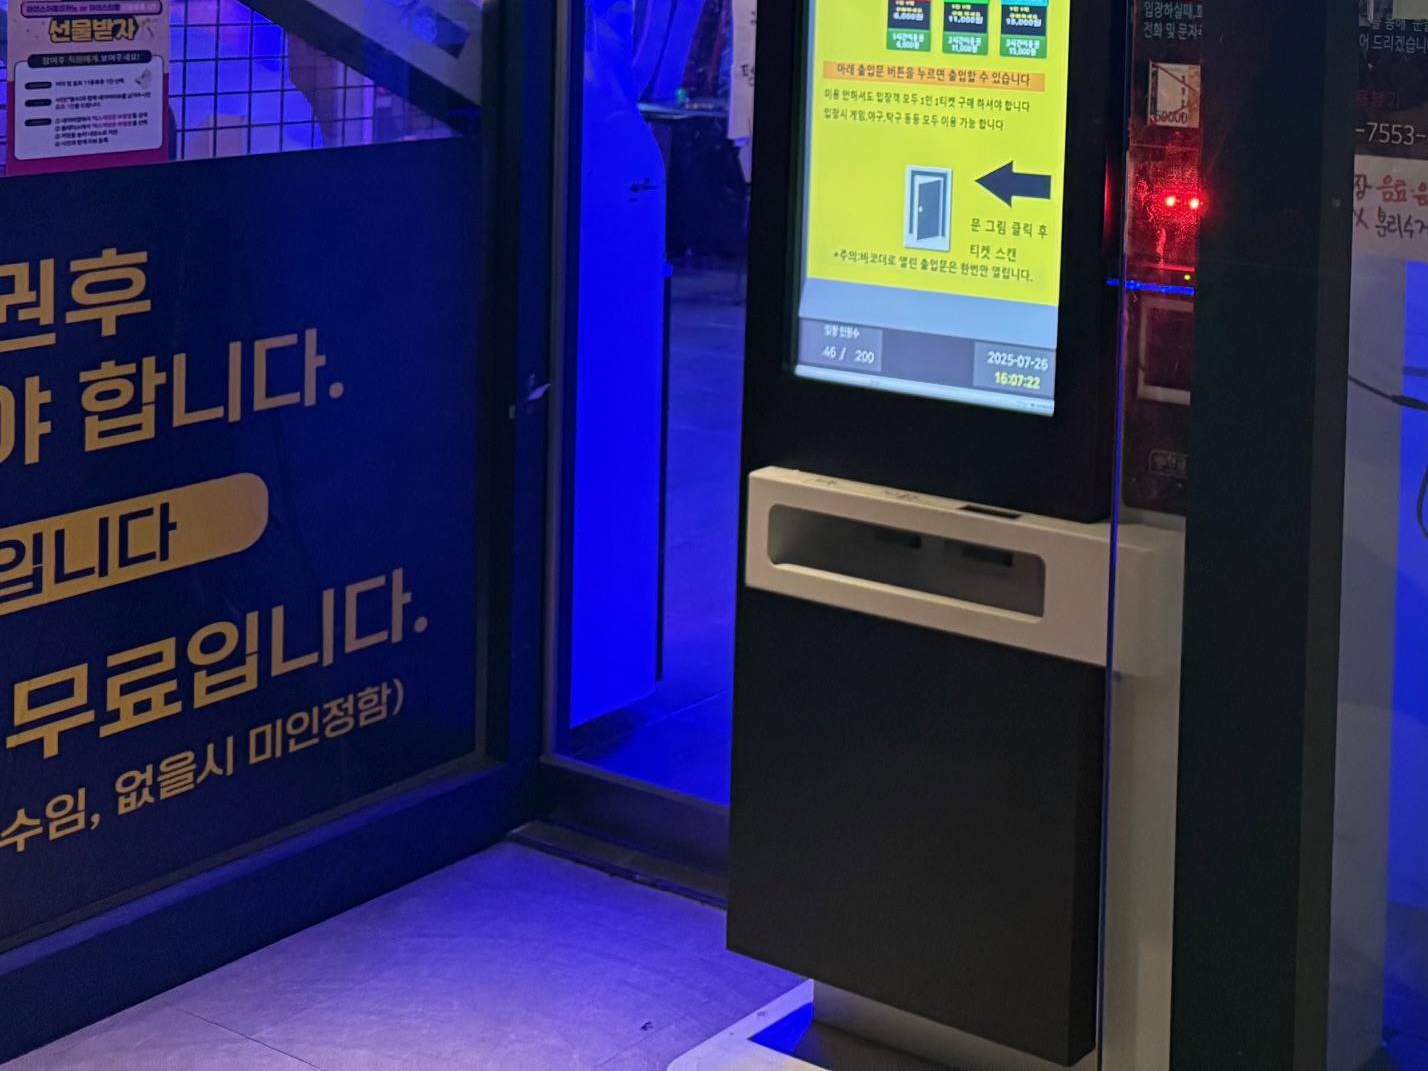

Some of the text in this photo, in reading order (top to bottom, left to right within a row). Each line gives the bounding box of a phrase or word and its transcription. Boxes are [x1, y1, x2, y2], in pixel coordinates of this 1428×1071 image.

[49, 18, 137, 43] 선물받자
[837, 63, 1030, 87] 아래 출입문 버튼을 누르면 출입할 수 있습니다
[902, 93, 919, 105] 모두
[1005, 99, 1031, 113] 합니다
[922, 114, 939, 127] 모두
[941, 116, 957, 128] 이용
[959, 117, 976, 130] 가능
[978, 118, 1004, 131] 합니다
[970, 217, 1048, 239] 문 그림 클릭 후
[970, 244, 1017, 262] 티켓 스캔
[899, 256, 1034, 283] 열린 출입문은 한번만 열립니다.
[986, 350, 1049, 372] 2025-07-26
[79, 328, 345, 452] 합니다.
[994, 371, 1041, 390] 16:07:22
[6, 567, 429, 759] 무료입니다.
[114, 735, 235, 816] 없을시
[248, 678, 405, 764] 미인정함)
